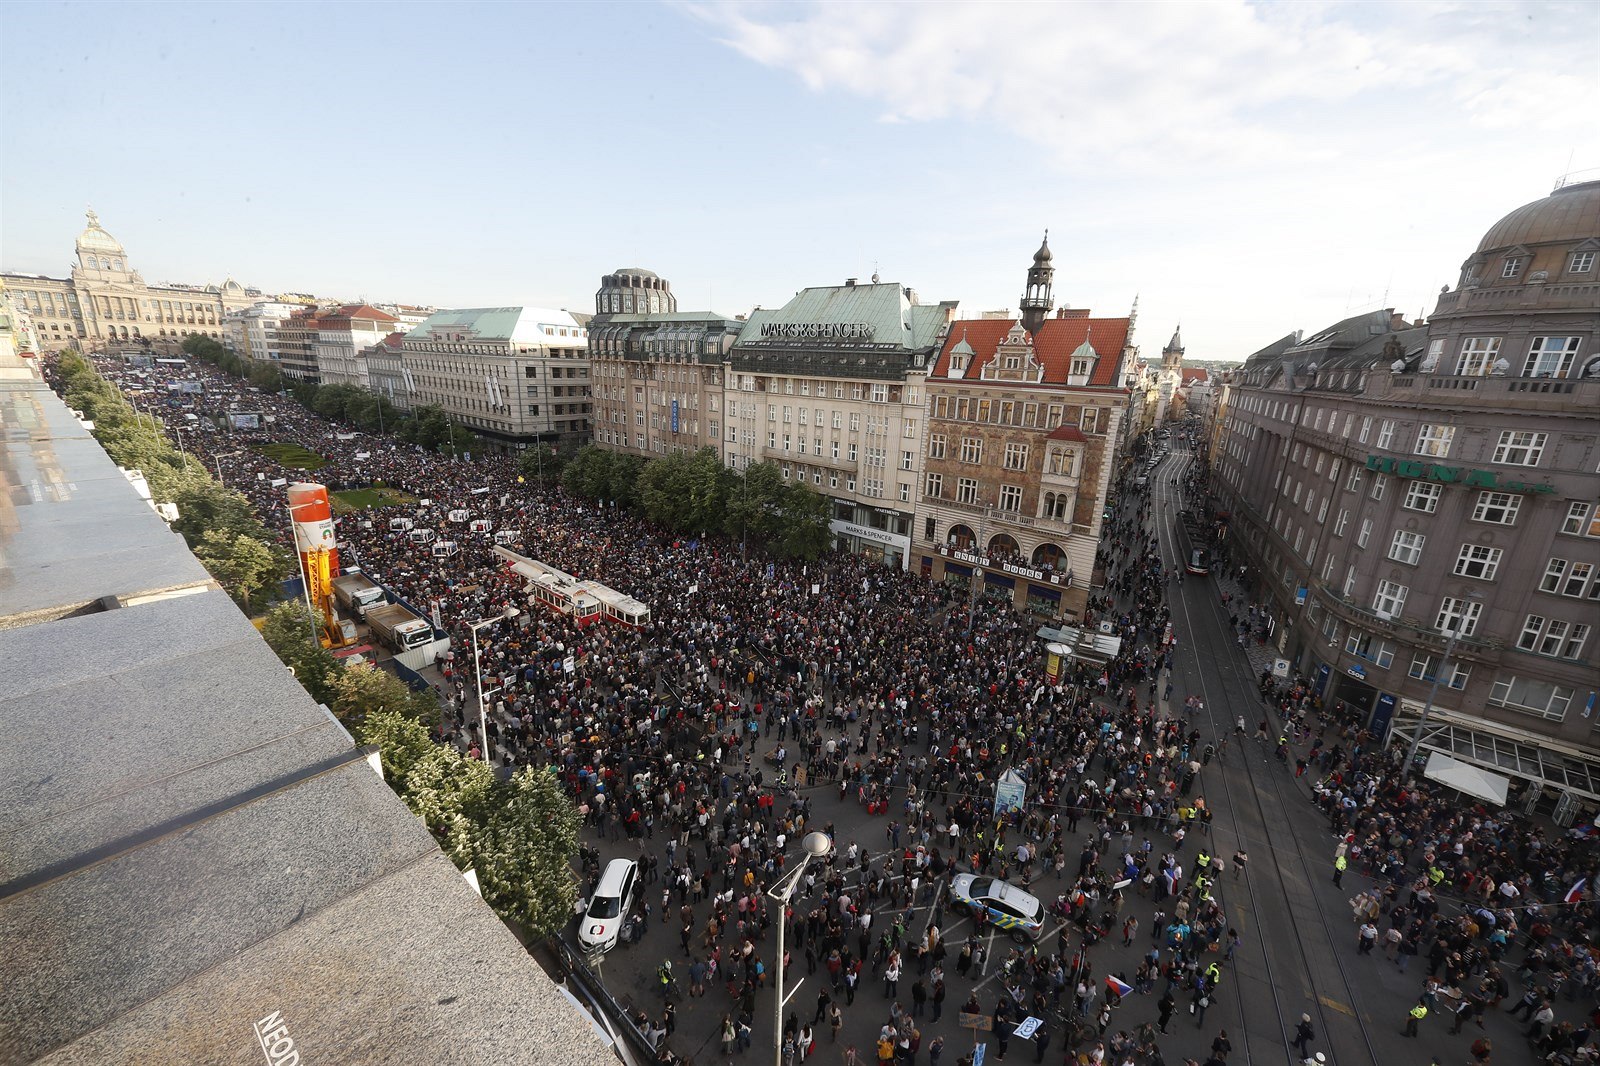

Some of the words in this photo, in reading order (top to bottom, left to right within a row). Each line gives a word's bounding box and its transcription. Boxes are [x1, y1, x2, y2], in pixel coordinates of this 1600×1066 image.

[760, 322, 869, 338] MARKS&SPENCER
[845, 525, 864, 535] MARKS
[867, 531, 893, 542] SPENCER
[1004, 563, 1042, 579] BOOKS
[258, 1009, 304, 1066] NEOD
